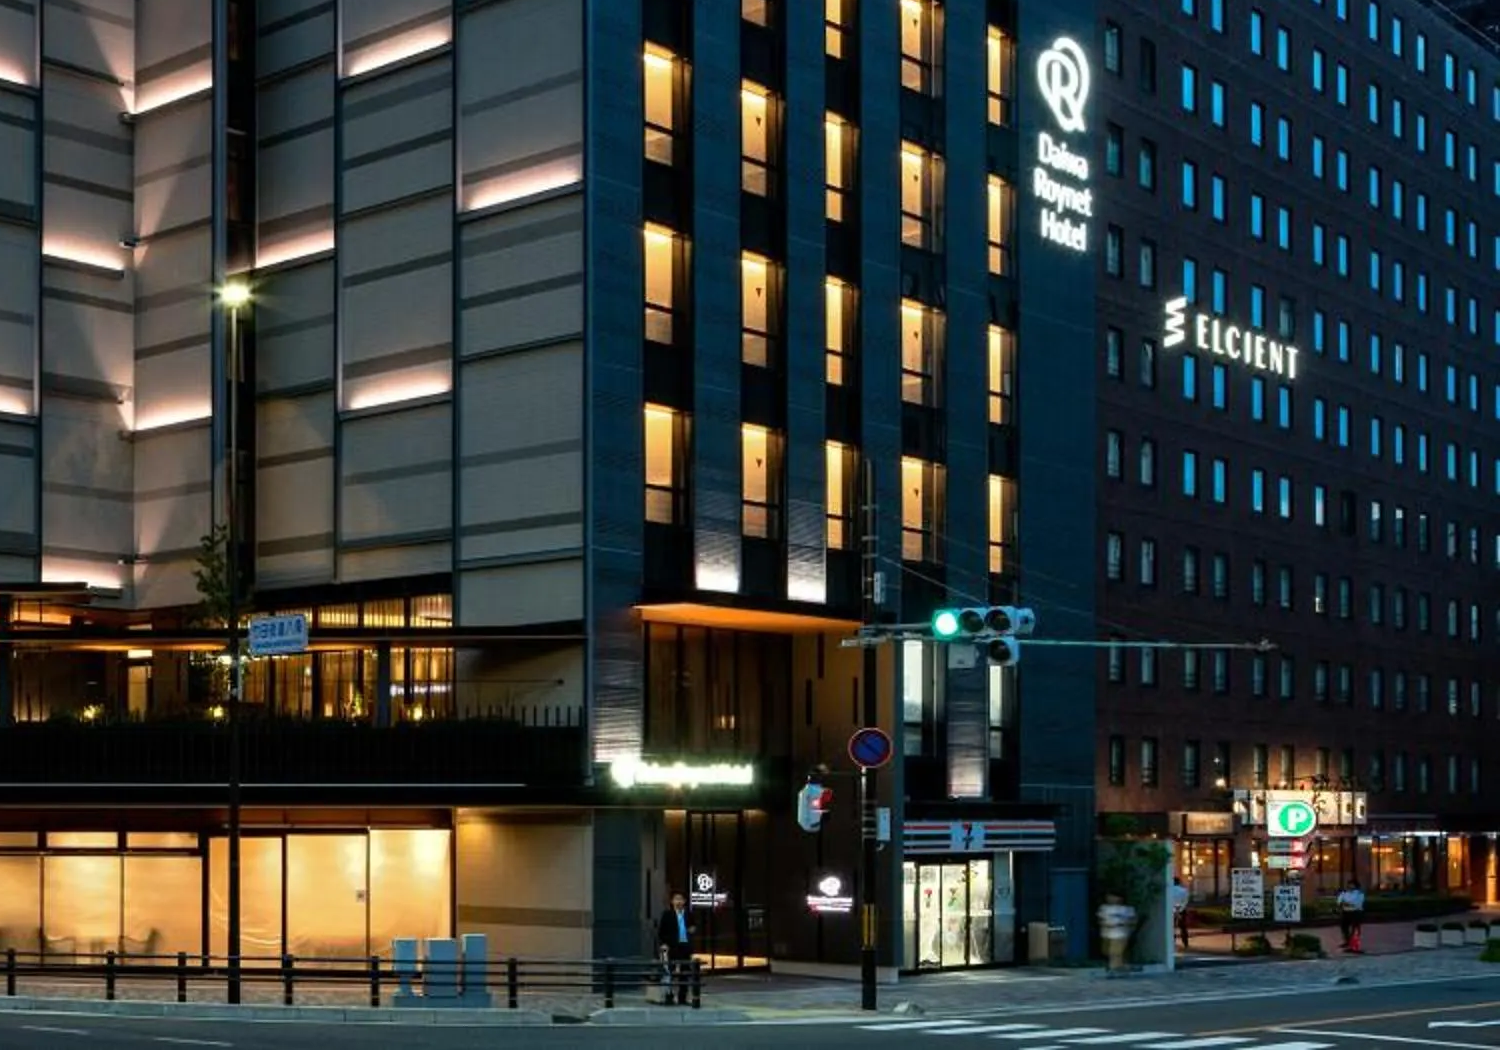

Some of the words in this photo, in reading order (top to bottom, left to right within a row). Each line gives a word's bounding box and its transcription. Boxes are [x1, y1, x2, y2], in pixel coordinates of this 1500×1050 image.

[1038, 131, 1088, 181] Daiwa
[1033, 166, 1093, 217] Roynet
[1040, 207, 1087, 252] Hotel
[1196, 313, 1299, 379] ELCIENT
[1287, 808, 1308, 831] P
